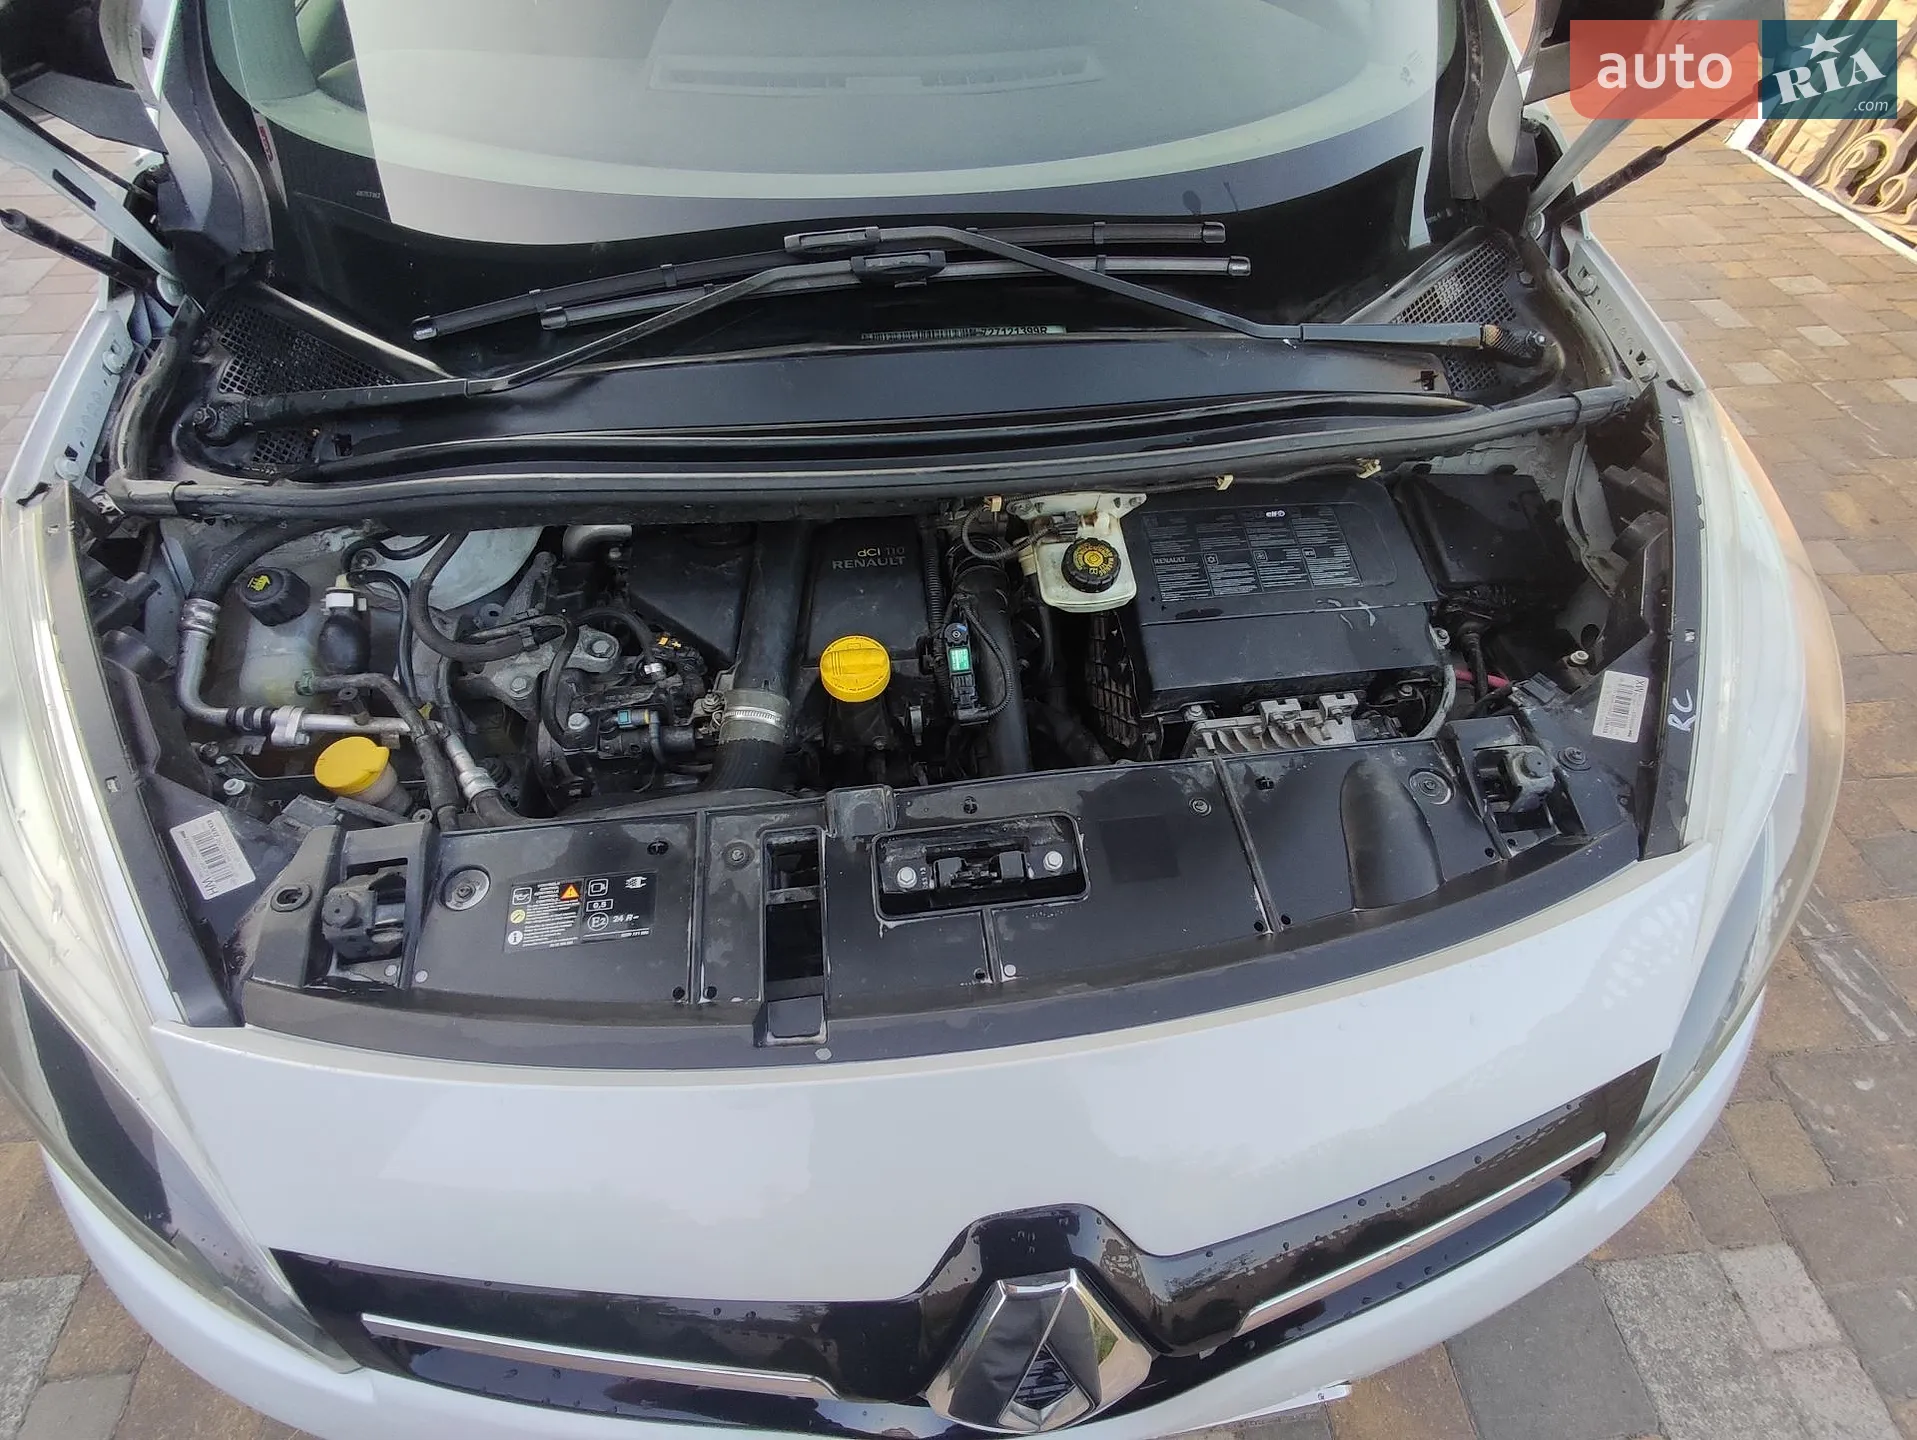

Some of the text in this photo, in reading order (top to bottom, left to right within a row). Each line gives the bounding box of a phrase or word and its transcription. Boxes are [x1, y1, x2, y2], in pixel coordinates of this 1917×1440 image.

[831, 556, 906, 569] RENAULT
[1153, 556, 1187, 565] RENAULT
[1667, 689, 1697, 732] RC
[591, 916, 607, 928] E2
